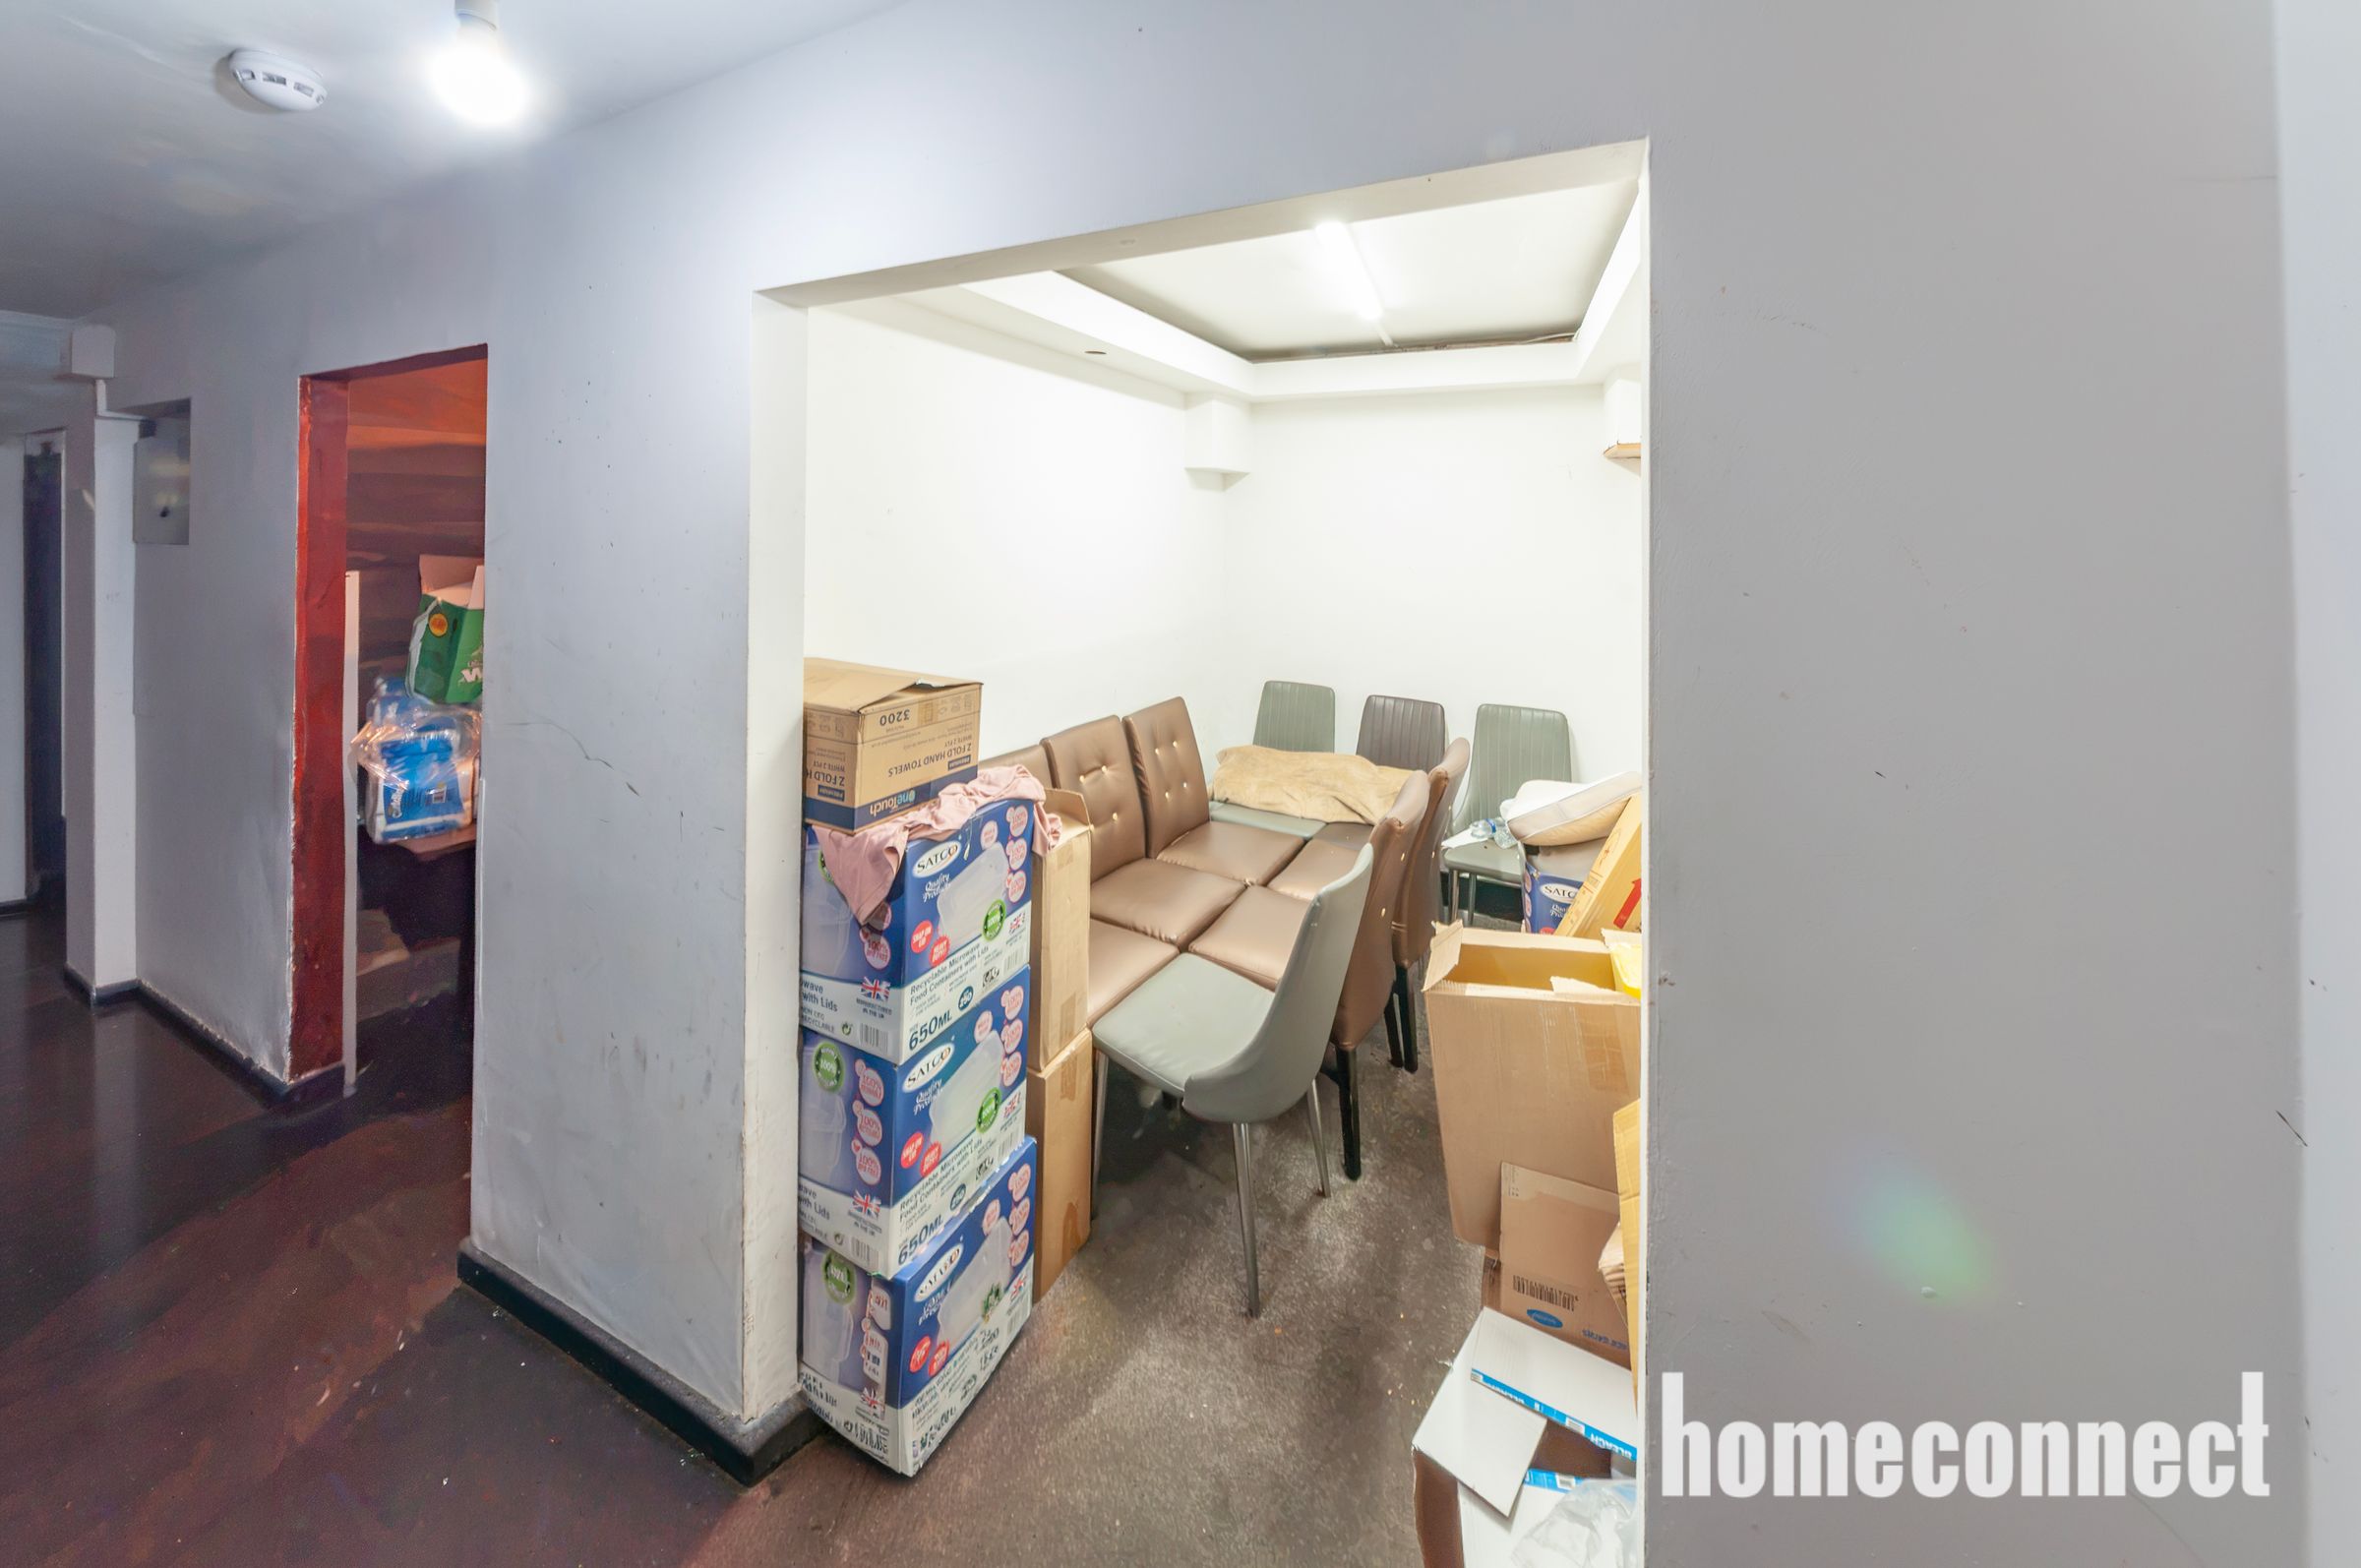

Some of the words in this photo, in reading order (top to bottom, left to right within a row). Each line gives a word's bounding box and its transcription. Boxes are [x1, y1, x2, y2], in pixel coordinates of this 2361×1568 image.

[879, 709, 910, 726] 3200
[946, 745, 965, 758] FOLD
[967, 743, 971, 752] Z
[924, 751, 945, 765] HAND
[888, 759, 922, 777] TOWELS
[815, 771, 836, 784] FOLD
[839, 776, 844, 786] Z
[917, 844, 957, 874] SATCO
[925, 873, 949, 892] Quality
[1544, 885, 1576, 899] SATC
[910, 964, 946, 995] Recyclable
[948, 942, 980, 968] Microwave
[802, 981, 822, 994] wave
[910, 987, 927, 1006] Food
[929, 964, 962, 993] Containers
[964, 952, 976, 968] with
[802, 992, 818, 1005] with
[820, 996, 837, 1012] Lids
[909, 1009, 951, 1051] 650ML
[907, 1047, 950, 1088] SATCO
[814, 1203, 829, 1221] Lids
[898, 1214, 942, 1266] 650ML
